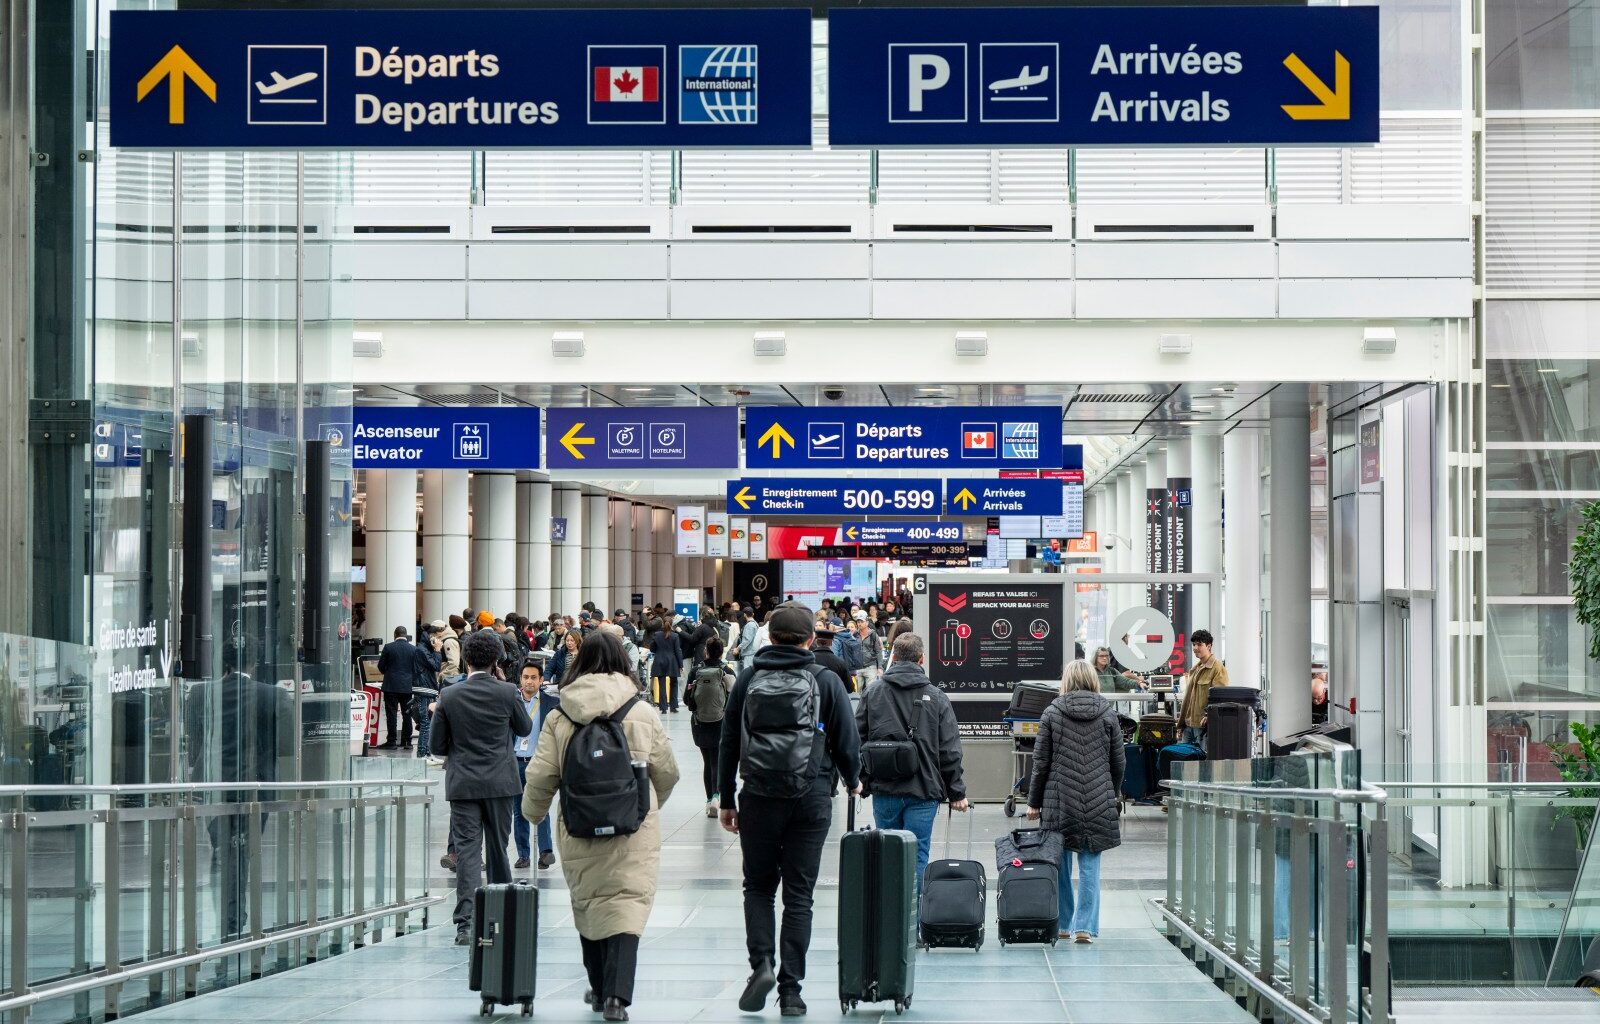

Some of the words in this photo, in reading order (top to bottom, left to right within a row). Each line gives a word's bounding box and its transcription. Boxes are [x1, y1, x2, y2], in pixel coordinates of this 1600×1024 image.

[354, 46, 499, 84] Départs
[1090, 43, 1242, 75] Arrivées
[685, 78, 752, 92] International
[908, 54, 951, 112] P
[354, 94, 560, 132] Departures
[1090, 91, 1231, 122] Arrivals
[354, 423, 440, 438] Ascenseur
[856, 423, 922, 439] Départs
[354, 445, 423, 460] Elevator
[856, 444, 949, 461] Departures
[762, 488, 838, 499] Enregistrement
[843, 489, 935, 509] 500-599
[983, 487, 1026, 498] Arrivées
[762, 499, 805, 510] Check-in
[983, 500, 1023, 511] Arrivals
[907, 527, 960, 539] 400-499
[1176, 516, 1184, 546] POINT
[931, 545, 965, 554] 300-399
[1176, 548, 1184, 592] MTING
[915, 577, 926, 591] 6
[100, 621, 125, 650] Centre
[126, 621, 136, 648] de
[136, 620, 157, 647] santé
[108, 664, 133, 693] Health
[133, 667, 157, 690] centre
